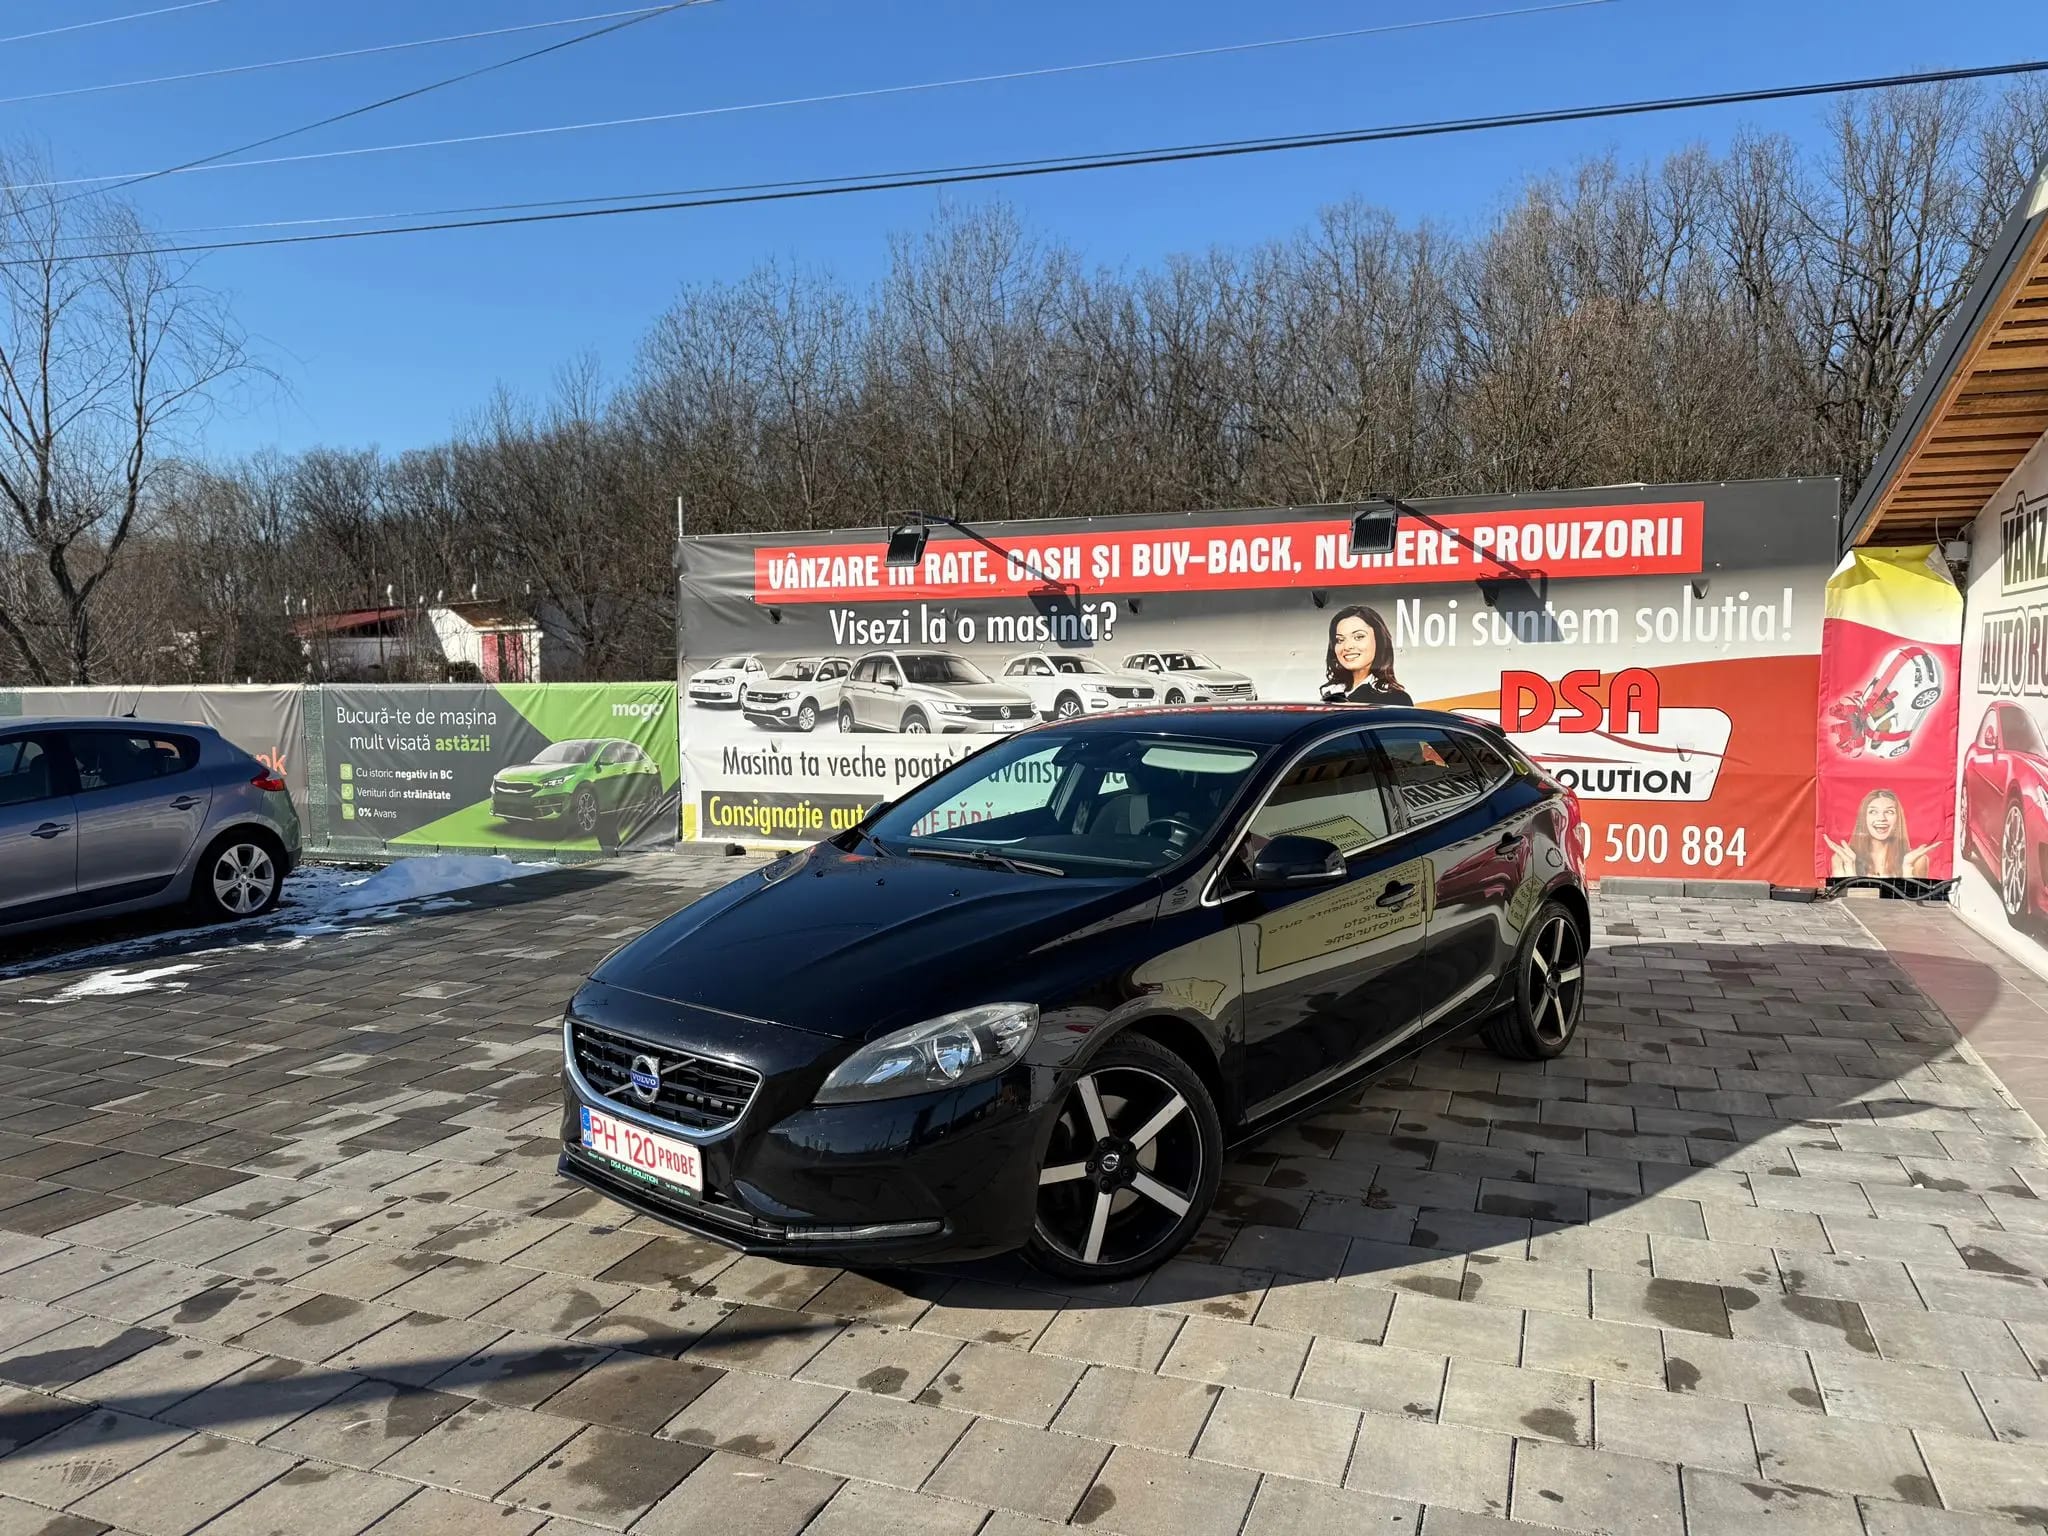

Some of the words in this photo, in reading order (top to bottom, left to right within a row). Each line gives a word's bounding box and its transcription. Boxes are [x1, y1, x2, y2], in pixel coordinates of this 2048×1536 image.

[768, 552, 880, 590] VÂNZARE
[925, 550, 997, 585] RATE,
[1006, 546, 1081, 582] CASH
[1092, 544, 1120, 587] ȘI
[1132, 536, 1302, 577] BUY-BACK,
[1472, 517, 1683, 564] PROVIZORII
[829, 608, 910, 645] Visezi
[921, 604, 947, 644] la
[958, 618, 976, 644] o
[987, 601, 1117, 650] mașină?
[1395, 598, 1458, 649] Noi
[1472, 600, 1619, 647] suntem
[1635, 584, 1793, 652] soluția!
[1980, 616, 2025, 687] AUTO
[612, 703, 664, 723] mogo
[1500, 668, 1660, 734] DSA
[337, 706, 411, 724] Bucură-te
[416, 708, 435, 725] de
[440, 708, 497, 729] mașina
[350, 734, 384, 751] mult
[387, 734, 431, 751] visată
[435, 734, 491, 752] astăzi!
[356, 768, 368, 778] Cu
[369, 768, 394, 778] istoric
[395, 769, 428, 781] negativ
[440, 770, 453, 780] BC
[800, 751, 820, 777] ta
[827, 745, 886, 777] veche
[356, 787, 387, 798] Venituri
[388, 788, 401, 799] din
[1549, 768, 1692, 794] OLUTION
[358, 807, 372, 817] 0%
[373, 808, 397, 819] Avans
[709, 795, 824, 836] Consignație
[831, 803, 867, 830] aut
[1604, 823, 1669, 864] 500
[1681, 825, 1747, 867] 884
[632, 1073, 656, 1086] VOLVO
[591, 1115, 618, 1154] PH
[624, 1129, 657, 1169] 120
[658, 1146, 697, 1178] PROBE
